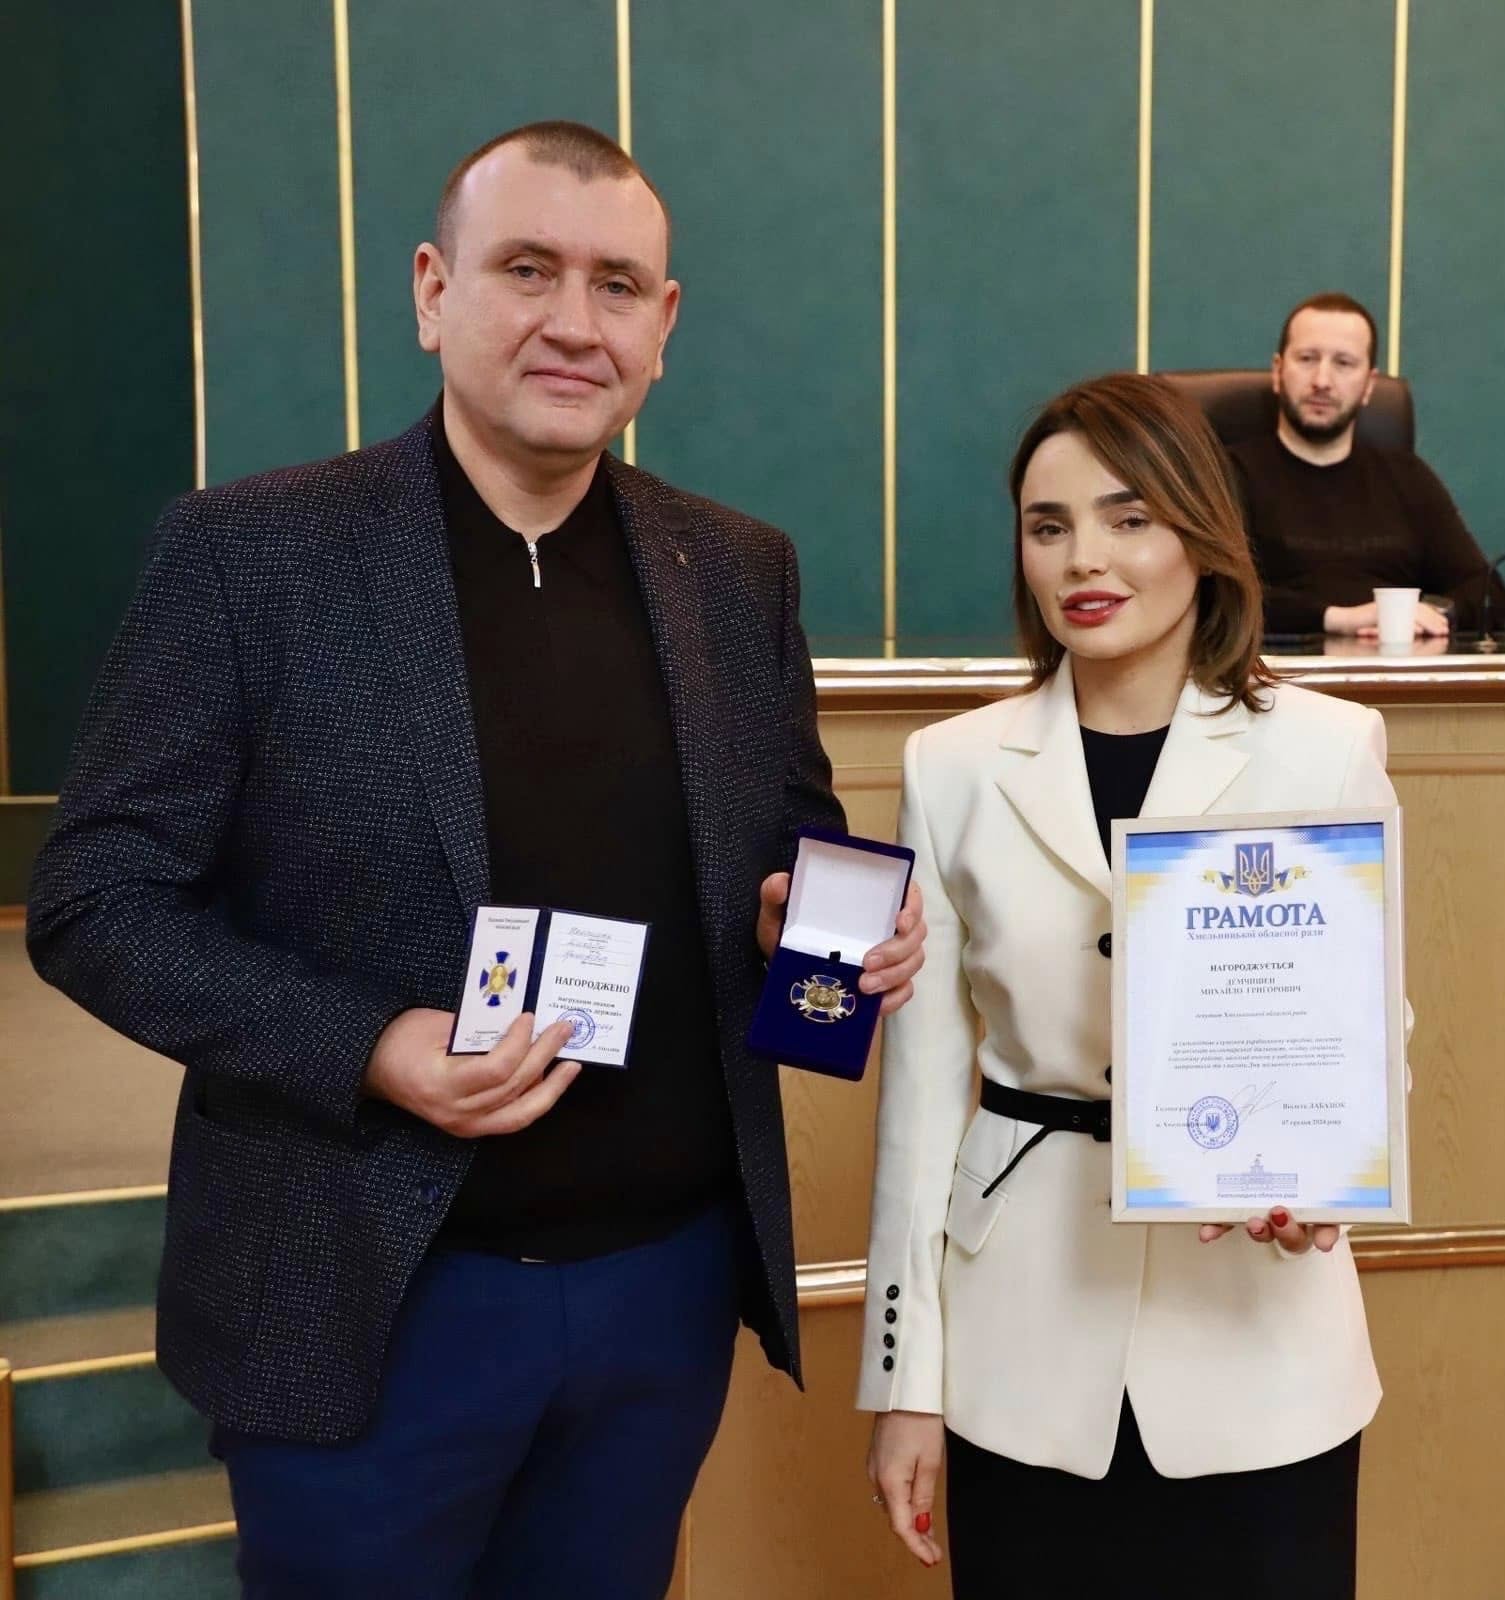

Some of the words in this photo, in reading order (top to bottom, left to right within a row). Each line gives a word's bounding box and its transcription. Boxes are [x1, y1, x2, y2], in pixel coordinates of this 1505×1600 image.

[1185, 903, 1327, 930] ГРАМОТА
[1187, 930, 1256, 941] Хмельницької
[1258, 929, 1299, 938] обласної
[1301, 929, 1324, 939] ради
[1210, 961, 1294, 972] НАГОРОДЖУЄТЬСЯ
[554, 975, 631, 994] НАГОРОДЖЕНО
[1200, 987, 1243, 996] МИХАЙЛО
[1247, 985, 1302, 994] ГРИГОРОВИЧ
